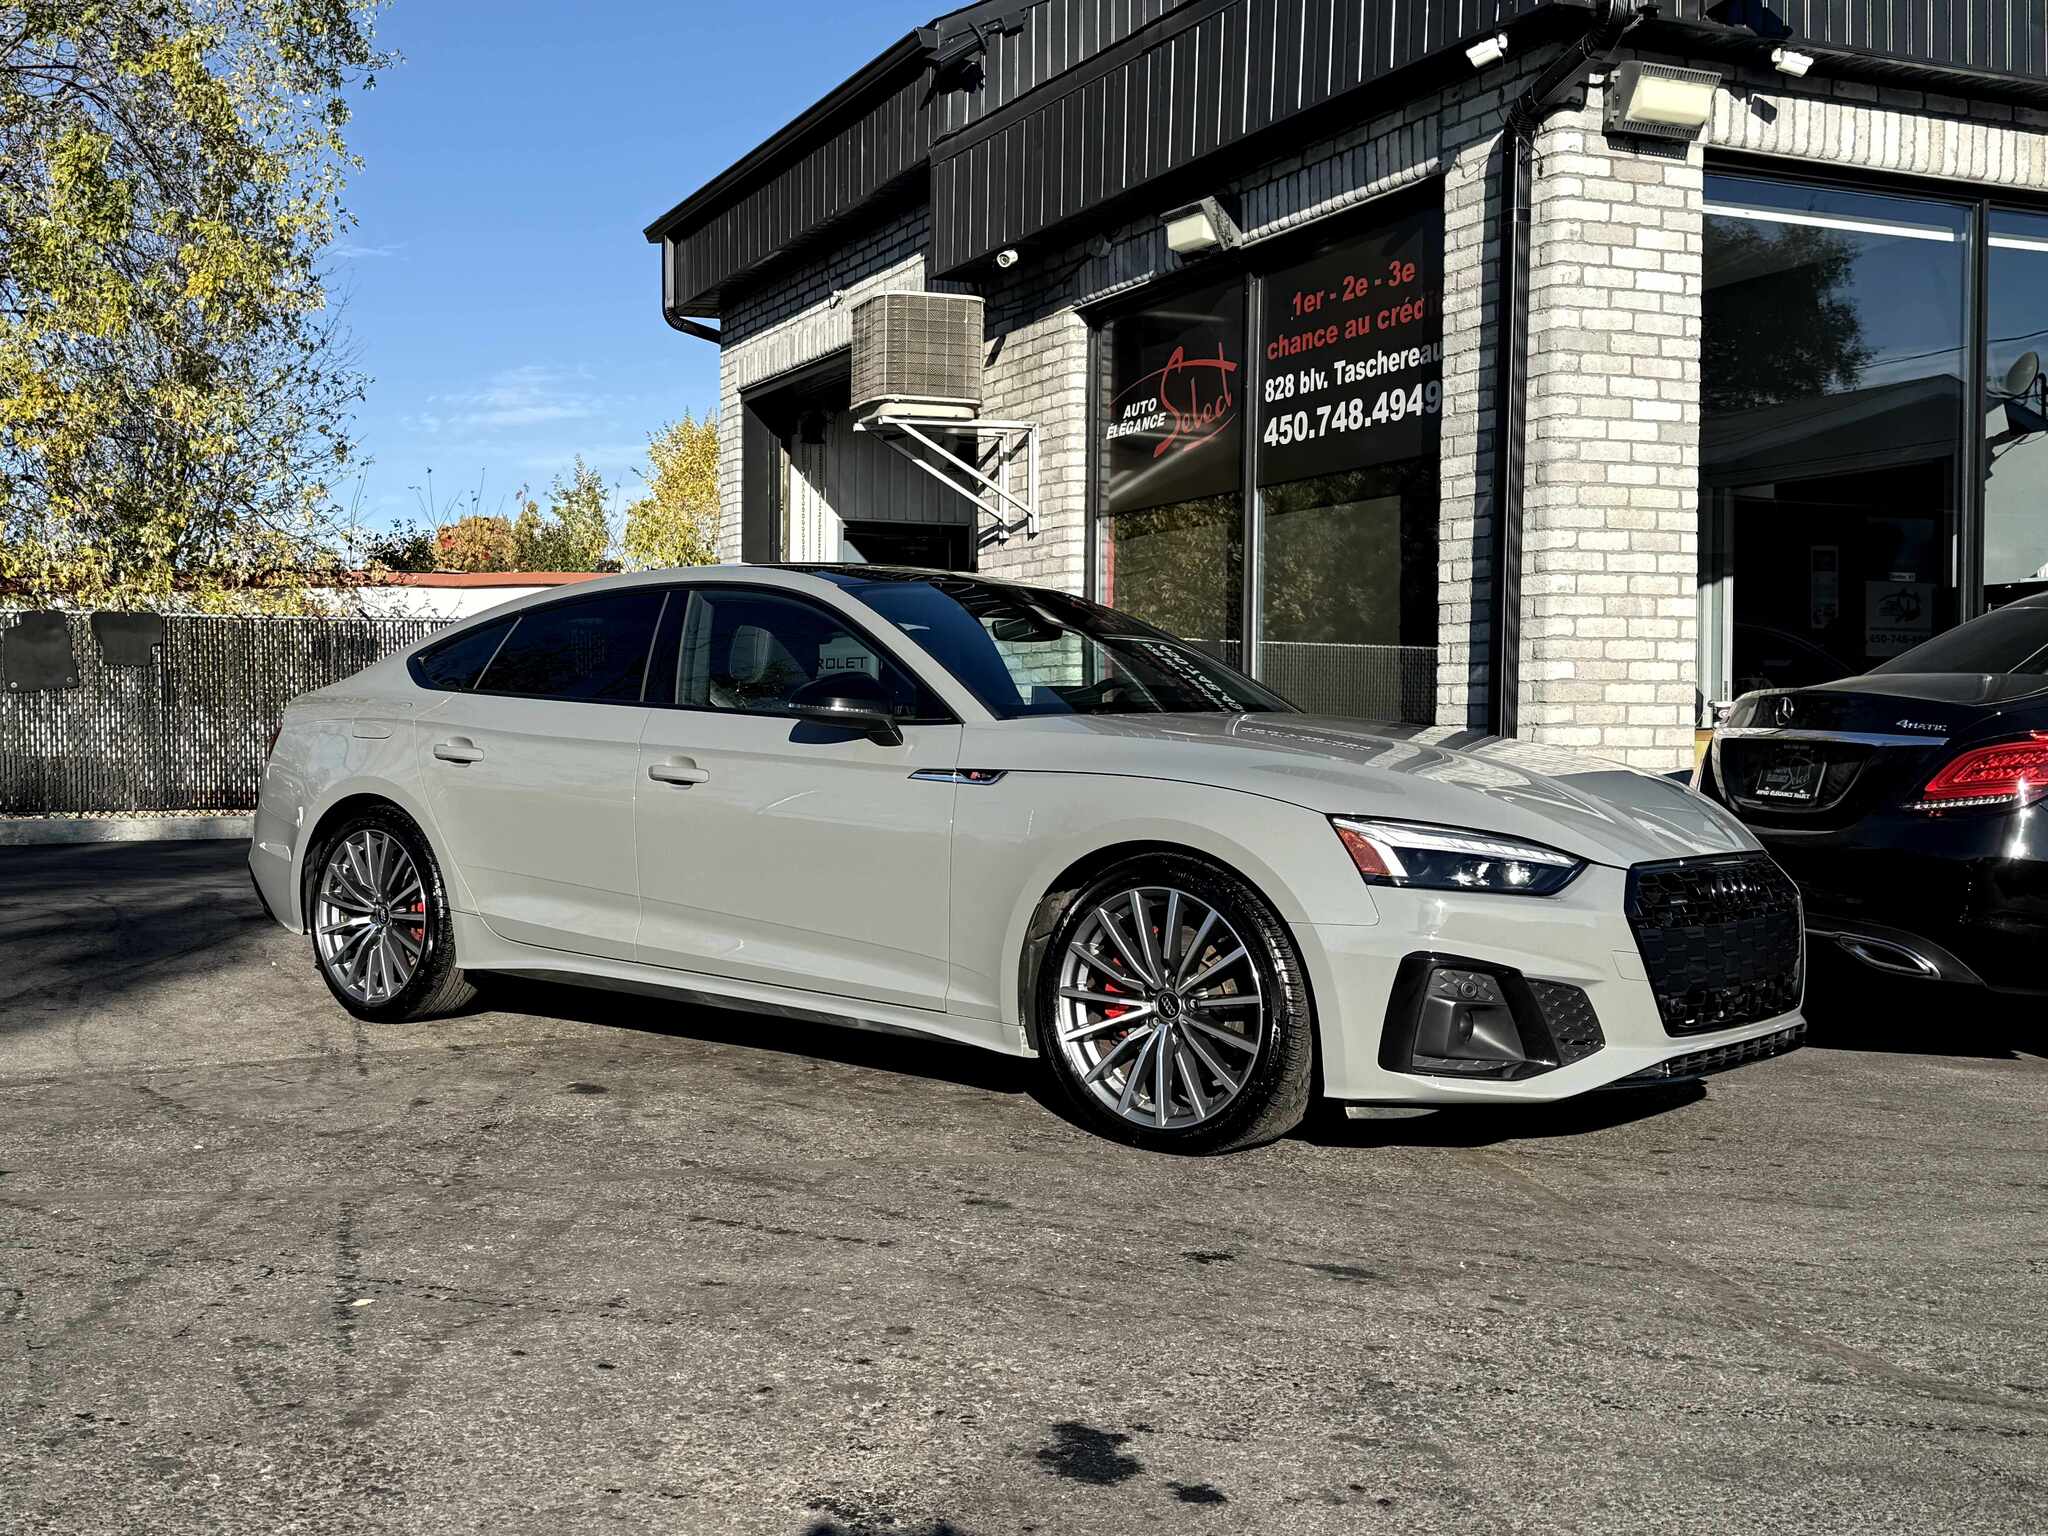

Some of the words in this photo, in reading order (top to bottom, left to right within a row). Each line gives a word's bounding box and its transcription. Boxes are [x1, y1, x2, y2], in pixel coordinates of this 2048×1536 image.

[1292, 290, 1325, 316] 1er
[1342, 275, 1369, 301] 2e
[1388, 260, 1416, 287] 3e
[1267, 325, 1339, 360] chance
[1344, 315, 1371, 339] au
[1264, 373, 1295, 402] 828
[1299, 368, 1328, 395] blv.
[1333, 340, 1442, 385] Taschereau
[1105, 412, 1167, 440] ÉLÉGANCE
[1122, 398, 1157, 419] AUTO
[1152, 341, 1238, 458] Select
[1263, 379, 1442, 447] 450.748.4949
